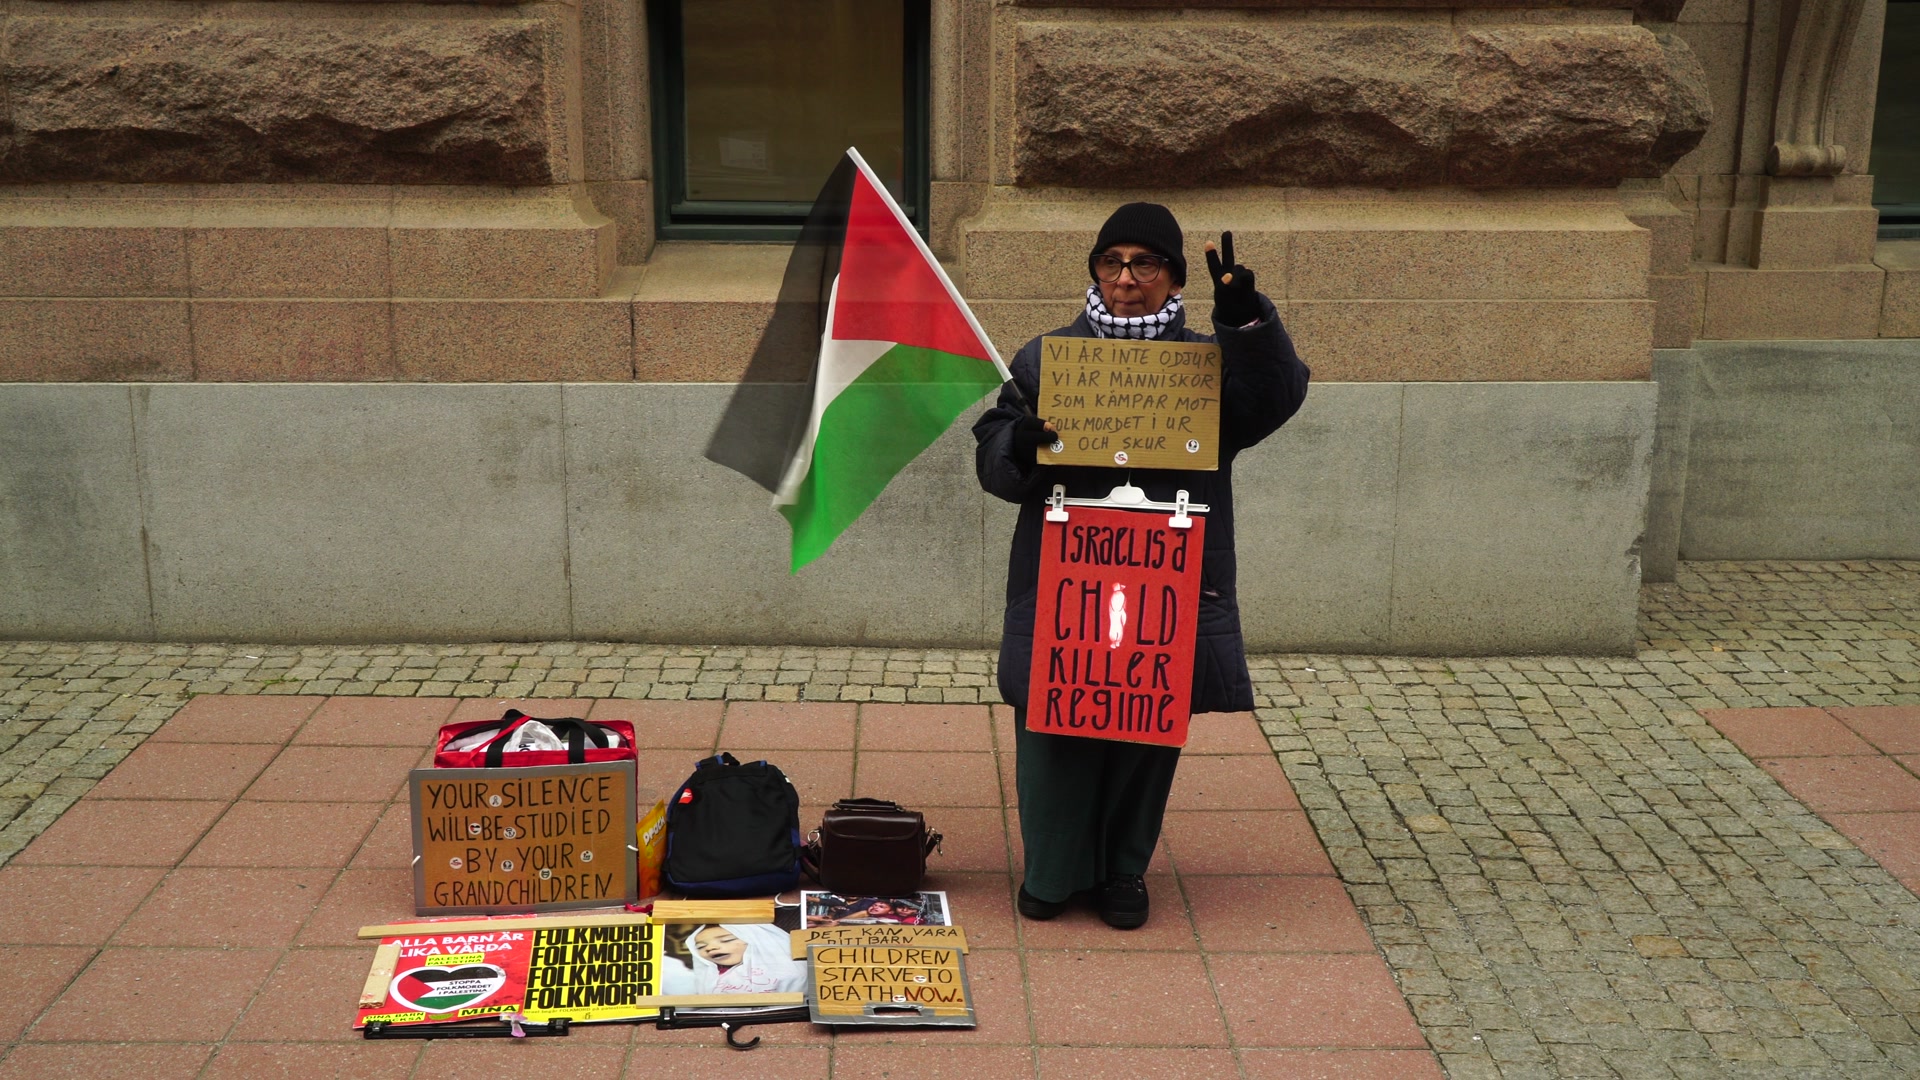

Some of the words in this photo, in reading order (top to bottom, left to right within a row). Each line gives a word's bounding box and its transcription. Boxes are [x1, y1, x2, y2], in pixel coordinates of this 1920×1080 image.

[1111, 343, 1152, 365] INTE
[1159, 351, 1217, 369] ODJUR
[1051, 393, 1085, 409] SOM
[1095, 390, 1168, 410] KÄMPAR
[1174, 396, 1218, 411] MOT
[1166, 416, 1193, 433] UR
[1078, 436, 1109, 451] OCH
[1122, 436, 1167, 451] SKUR
[427, 783, 490, 809] YOUR
[501, 776, 611, 809] SILENCE
[482, 815, 504, 842] BE
[514, 806, 611, 840] STUDIED
[466, 848, 498, 874] BY
[516, 843, 574, 872] YOUR
[434, 872, 613, 907] GRANDCHILDREN
[391, 937, 438, 948] ALLA
[442, 934, 494, 945] BARN
[496, 931, 525, 942] ÄR
[534, 924, 653, 947] FOLKMORD
[805, 929, 852, 942] DET
[861, 927, 903, 936] KAN
[912, 928, 958, 937] VARA
[868, 936, 914, 945] BARN
[399, 947, 442, 958] LIKA
[445, 942, 513, 955] VÄRDA
[428, 954, 483, 962] PALESTINA
[531, 941, 653, 967] FOLKMORD
[817, 946, 951, 965] CHILDREN
[527, 962, 653, 988] FOLKMORD
[822, 967, 915, 983] STARVE
[922, 968, 953, 984] TO
[436, 983, 493, 991] FOLKMORDET
[820, 985, 894, 1002] DEATH
[524, 983, 653, 1010] FOLKMORD
[461, 1005, 518, 1016] MINA
